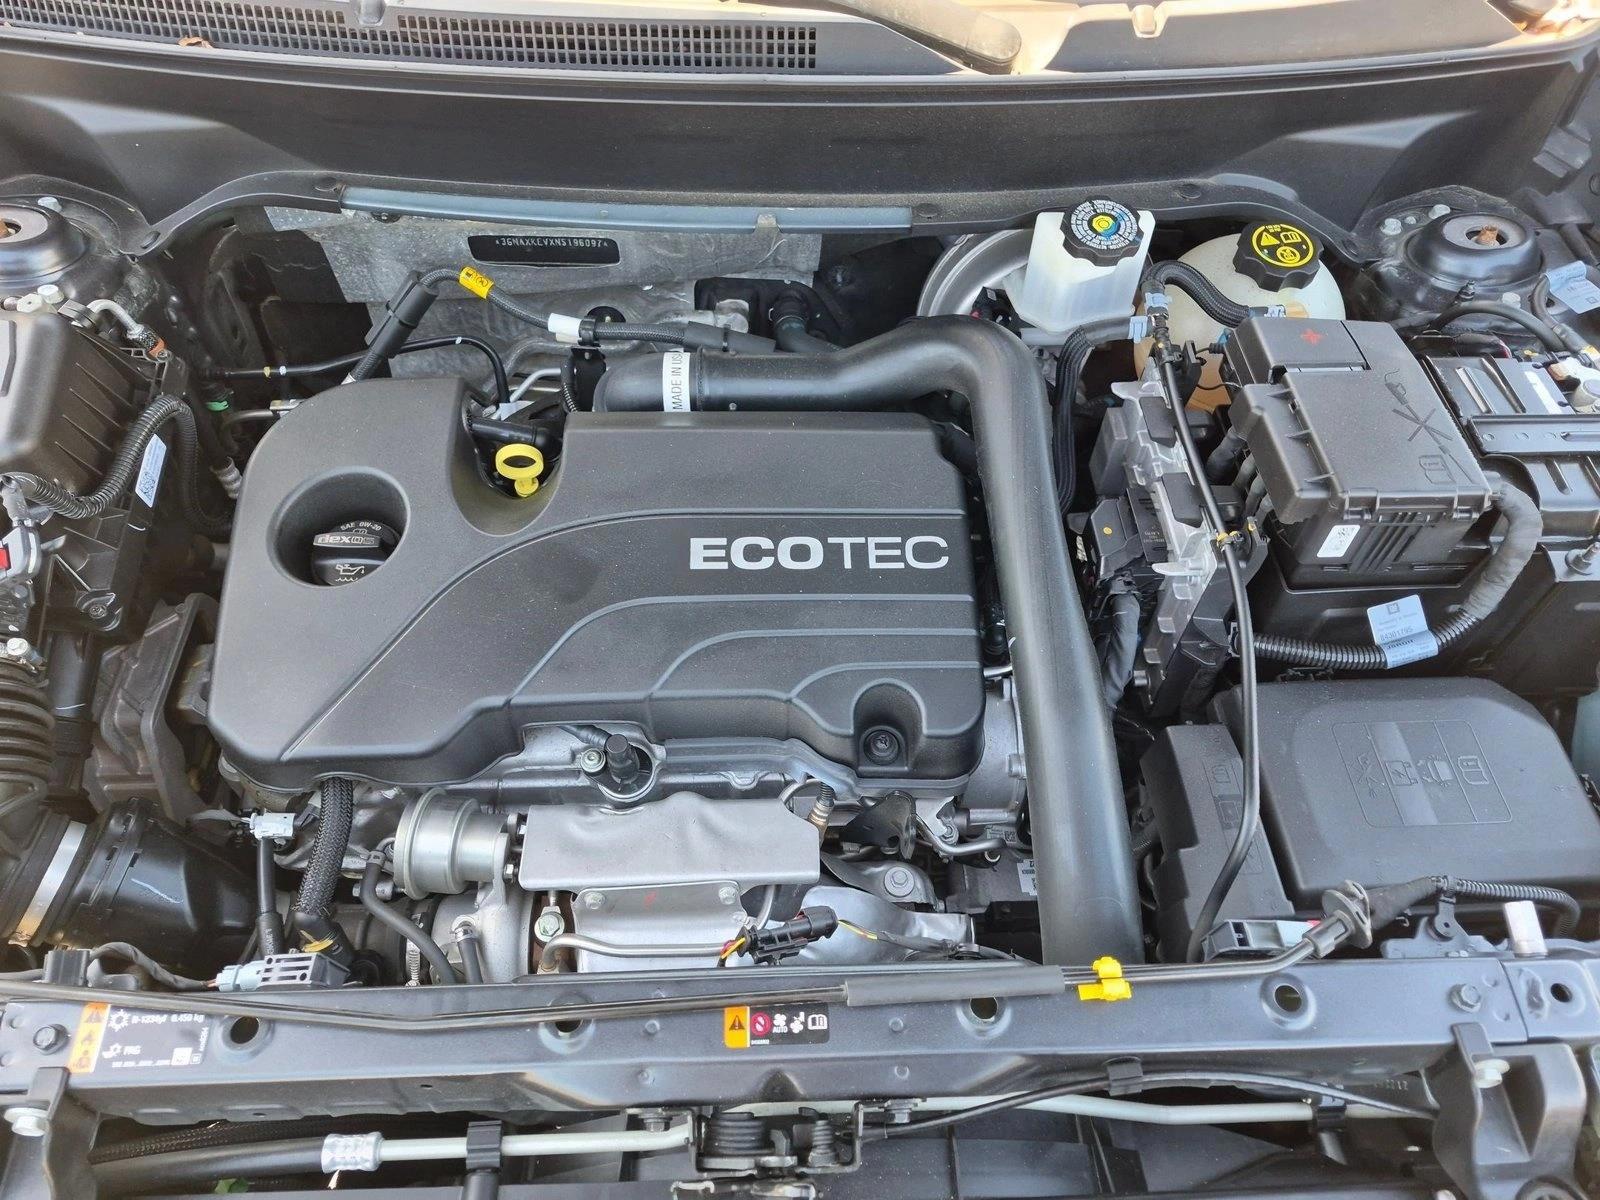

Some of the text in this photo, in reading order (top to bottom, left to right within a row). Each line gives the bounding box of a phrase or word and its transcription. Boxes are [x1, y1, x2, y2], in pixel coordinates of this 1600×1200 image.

[671, 367, 682, 377] IN
[671, 380, 684, 410] MADE
[317, 535, 376, 545] dexos
[689, 535, 950, 570] ECOTEC
[772, 1025, 789, 1034] AUTO
